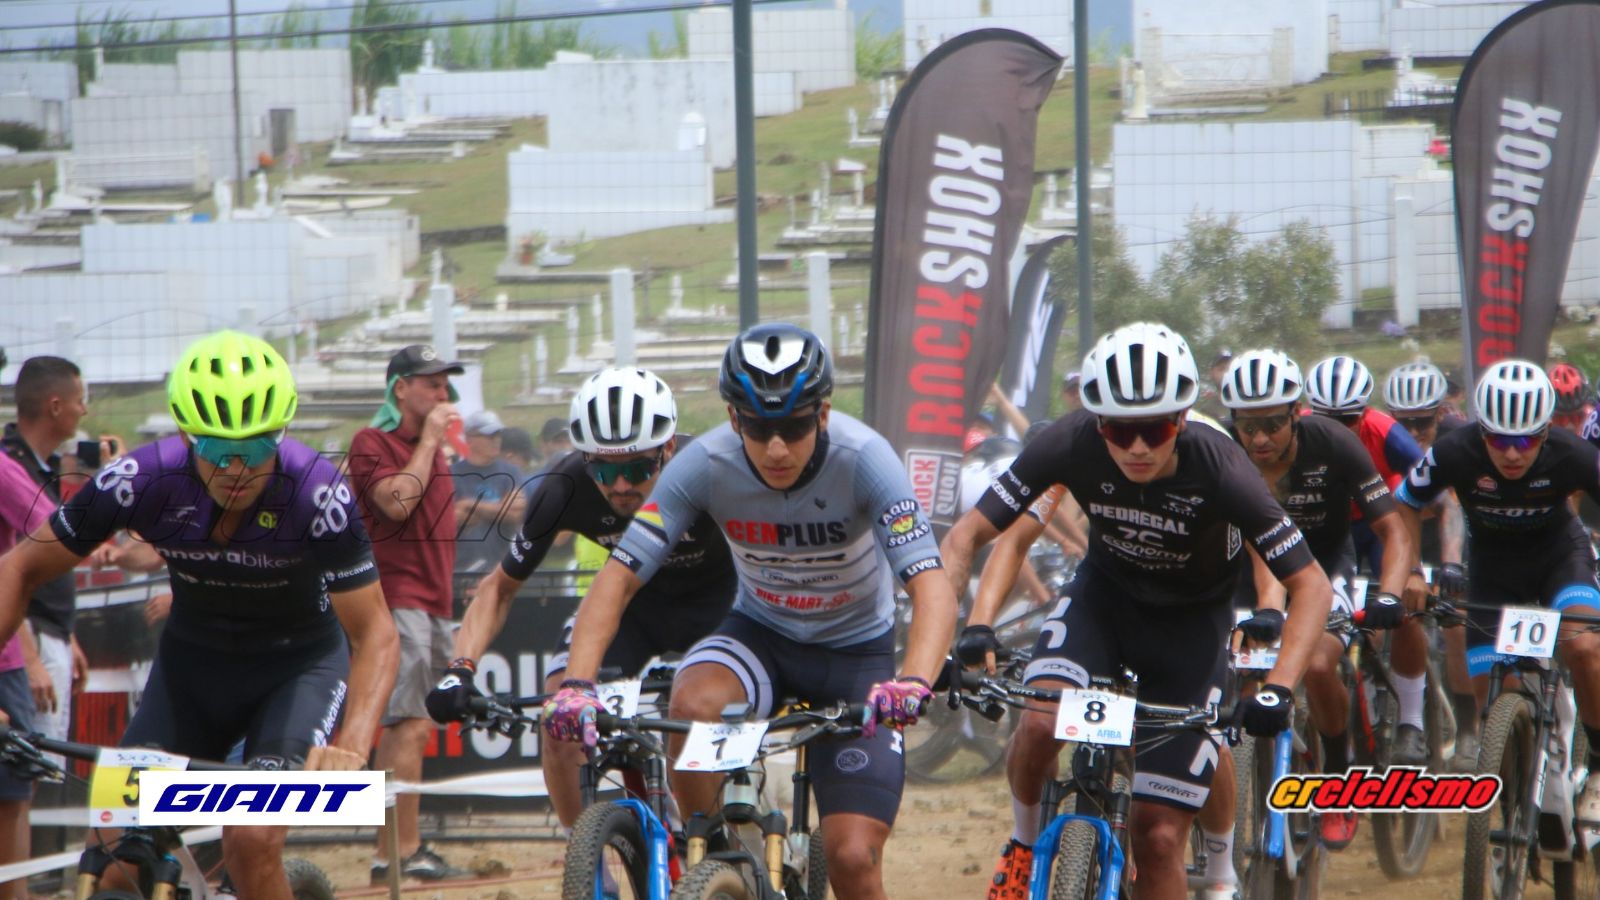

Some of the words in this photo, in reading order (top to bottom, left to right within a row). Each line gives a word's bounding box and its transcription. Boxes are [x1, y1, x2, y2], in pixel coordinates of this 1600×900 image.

[881, 500, 916, 525] AQUI
[1089, 502, 1190, 536] PEDREGAL
[725, 519, 848, 547] CENPLUS
[888, 523, 930, 547] SOPAS
[1266, 529, 1304, 561] KENDA
[906, 558, 938, 577] uvex
[1510, 620, 1546, 646] 10
[605, 694, 625, 718] 3
[1083, 700, 1107, 724] 8
[711, 737, 728, 761] 1
[122, 767, 140, 807] 5
